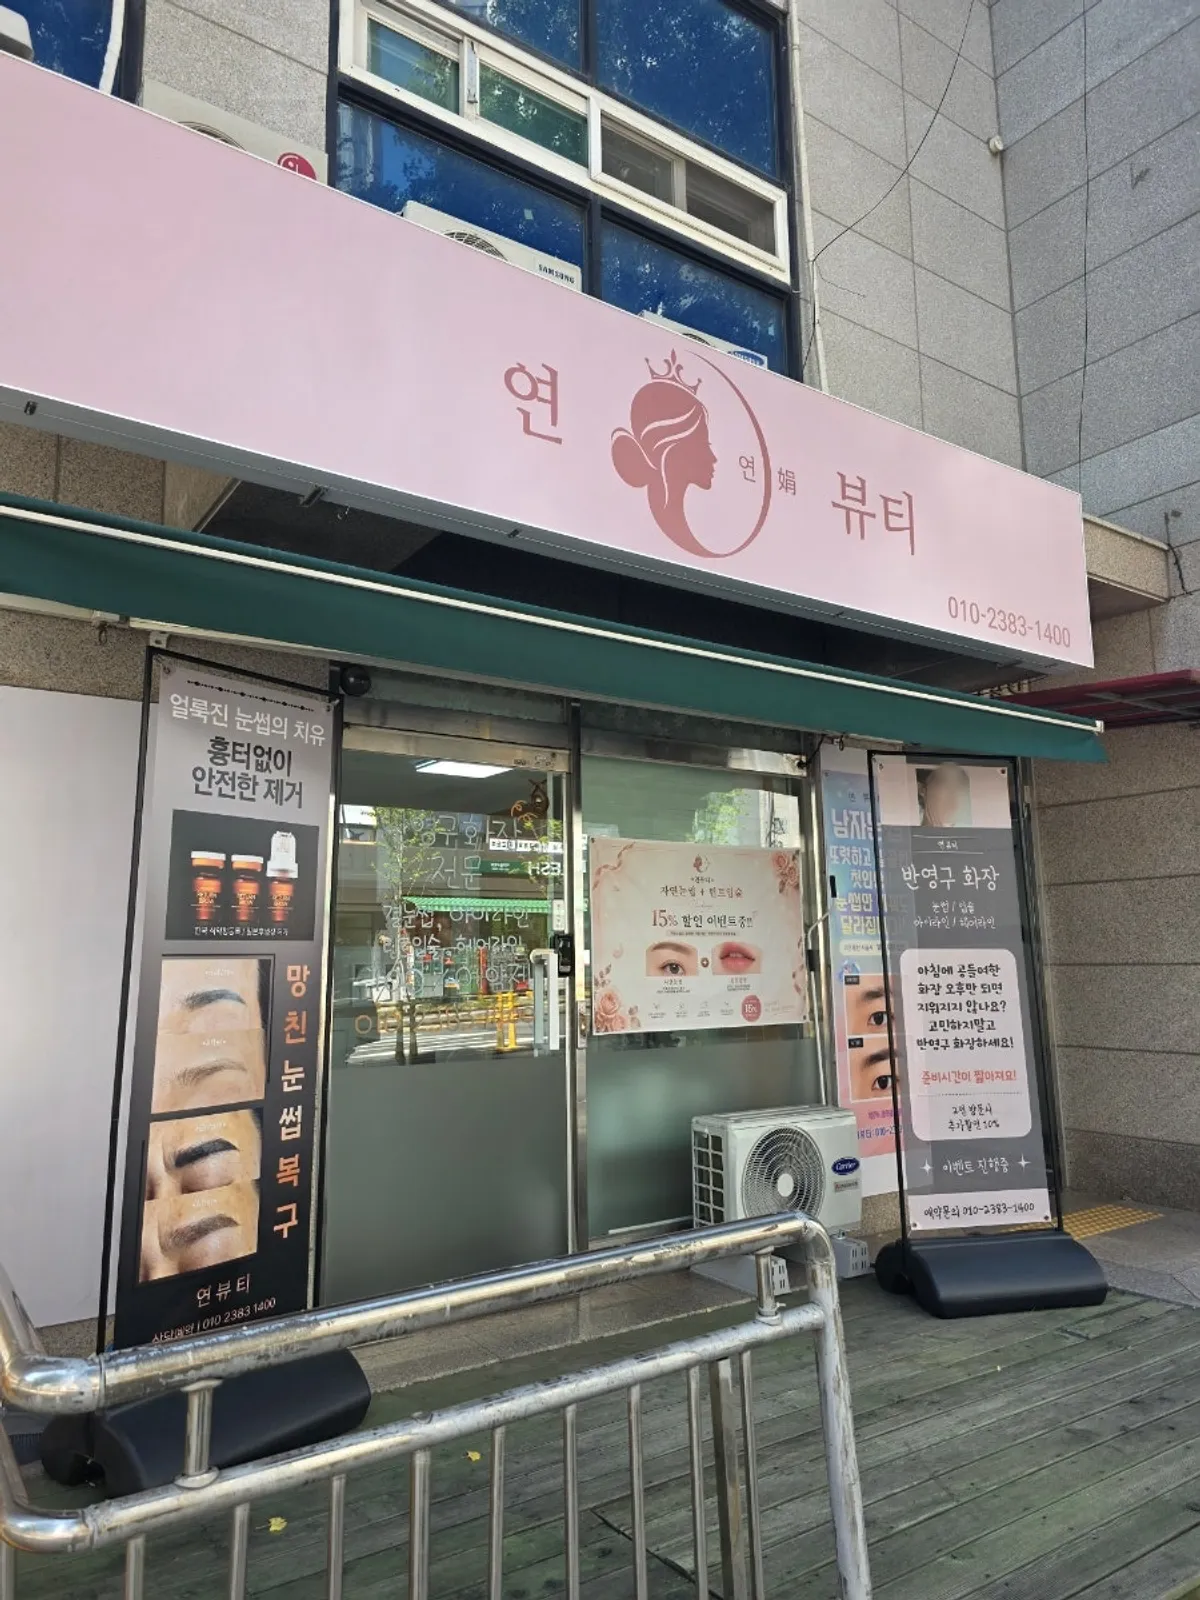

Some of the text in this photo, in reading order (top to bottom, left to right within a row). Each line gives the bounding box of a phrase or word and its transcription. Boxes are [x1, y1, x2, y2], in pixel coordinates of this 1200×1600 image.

[538, 263, 575, 284] SAMSUNG
[503, 363, 563, 445] 연
[738, 455, 756, 483] 연
[831, 472, 916, 556] 뷰티
[948, 596, 1071, 648] 010-2383-1400
[170, 693, 326, 747] 얼룩진 눈썹의 치유
[192, 766, 303, 809] 안전한 제거
[829, 846, 872, 866] 또렷하고
[901, 863, 1000, 891] 반영구 화장
[651, 909, 679, 928] 15%
[681, 914, 704, 929] 할인
[917, 963, 1001, 979] 아침에 공들여한
[917, 981, 1003, 996] 화장 오후만 되면
[917, 1000, 1007, 1015] 지워지지 않나요?
[928, 1019, 996, 1033] 고민하지말고
[916, 1036, 1015, 1051] 반영구 화장하세요!
[921, 1071, 971, 1085] 준비시간이
[942, 1157, 1010, 1176] 이벤트 진행중
[924, 1202, 1036, 1220] 예약문의 010-2383-1400
[203, 1315, 221, 1330] 010
[224, 1305, 250, 1323] 2383
[253, 1297, 276, 1314] 1400
